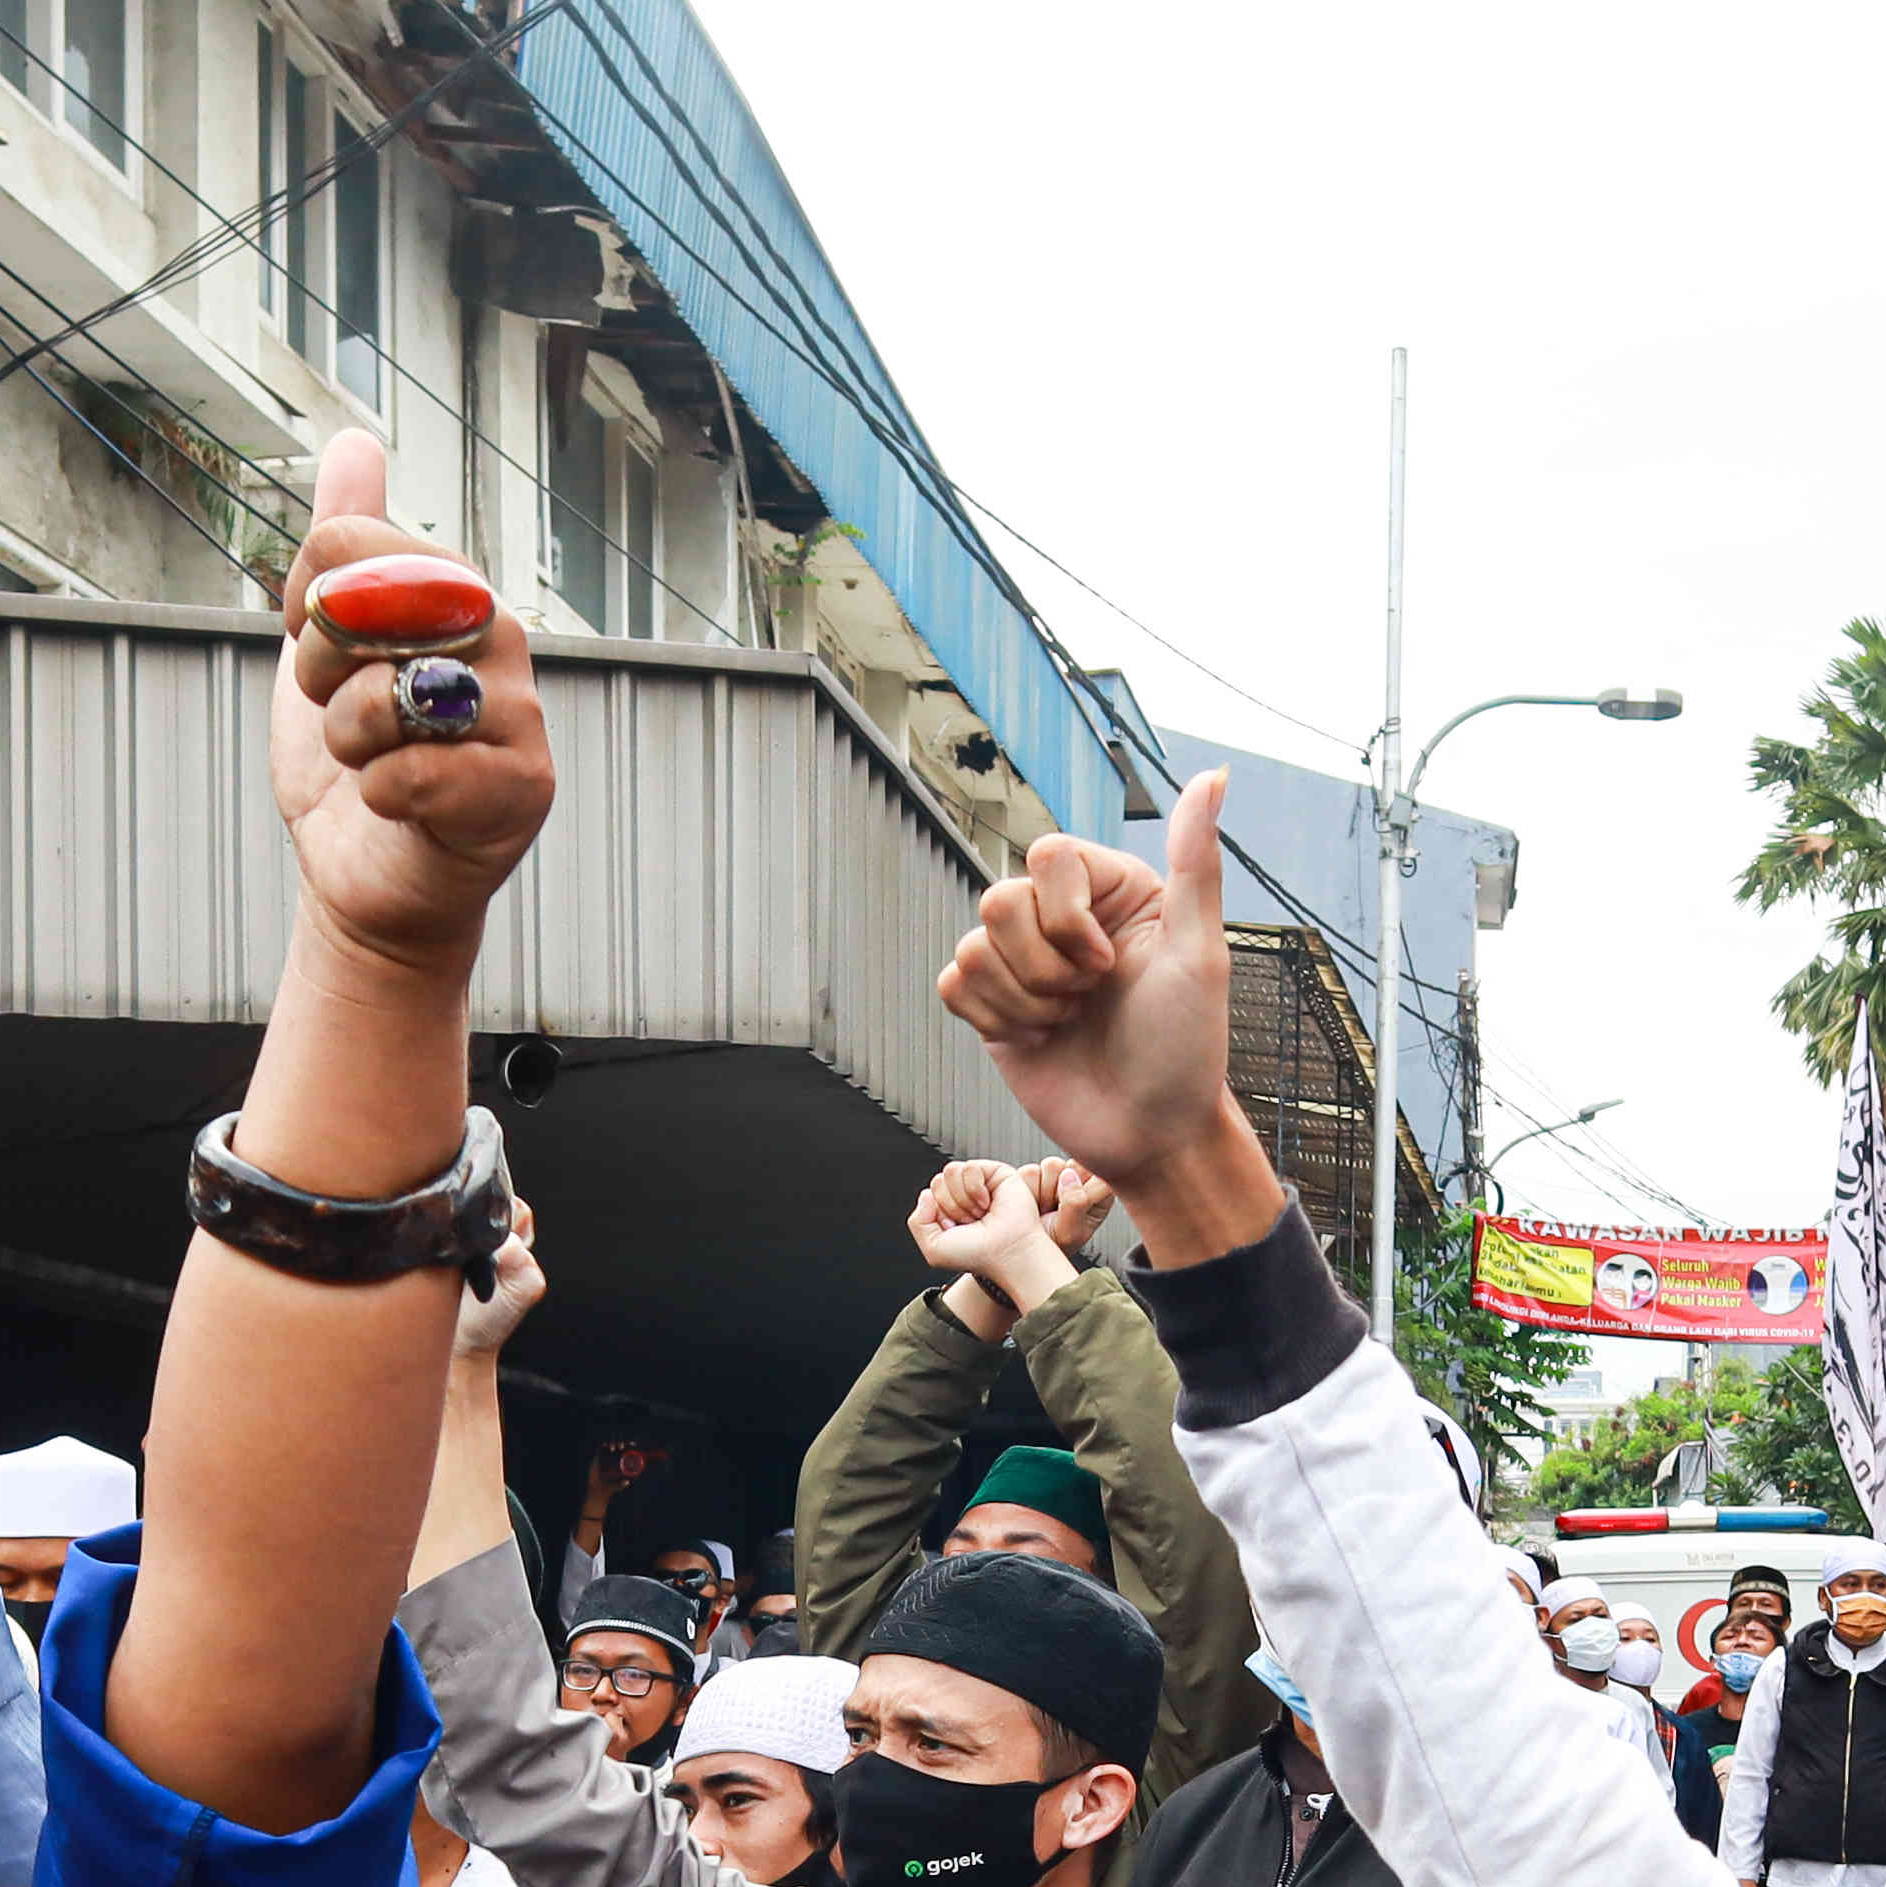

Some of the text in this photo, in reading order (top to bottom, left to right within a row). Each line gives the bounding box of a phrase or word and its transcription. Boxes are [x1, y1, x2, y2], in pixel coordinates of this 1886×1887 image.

[1518, 1216, 1685, 1242] KAWASAN
[1697, 1226, 1806, 1243] WAJIB
[1662, 1258, 1711, 1273] Seluruh
[1663, 1276, 1742, 1292] Warga Wajib
[1661, 1293, 1742, 1307] Pakai Masker
[1739, 1327, 1769, 1337] VIRUS
[1770, 1327, 1815, 1338] COVID-19
[926, 1851, 985, 1876] gojek
